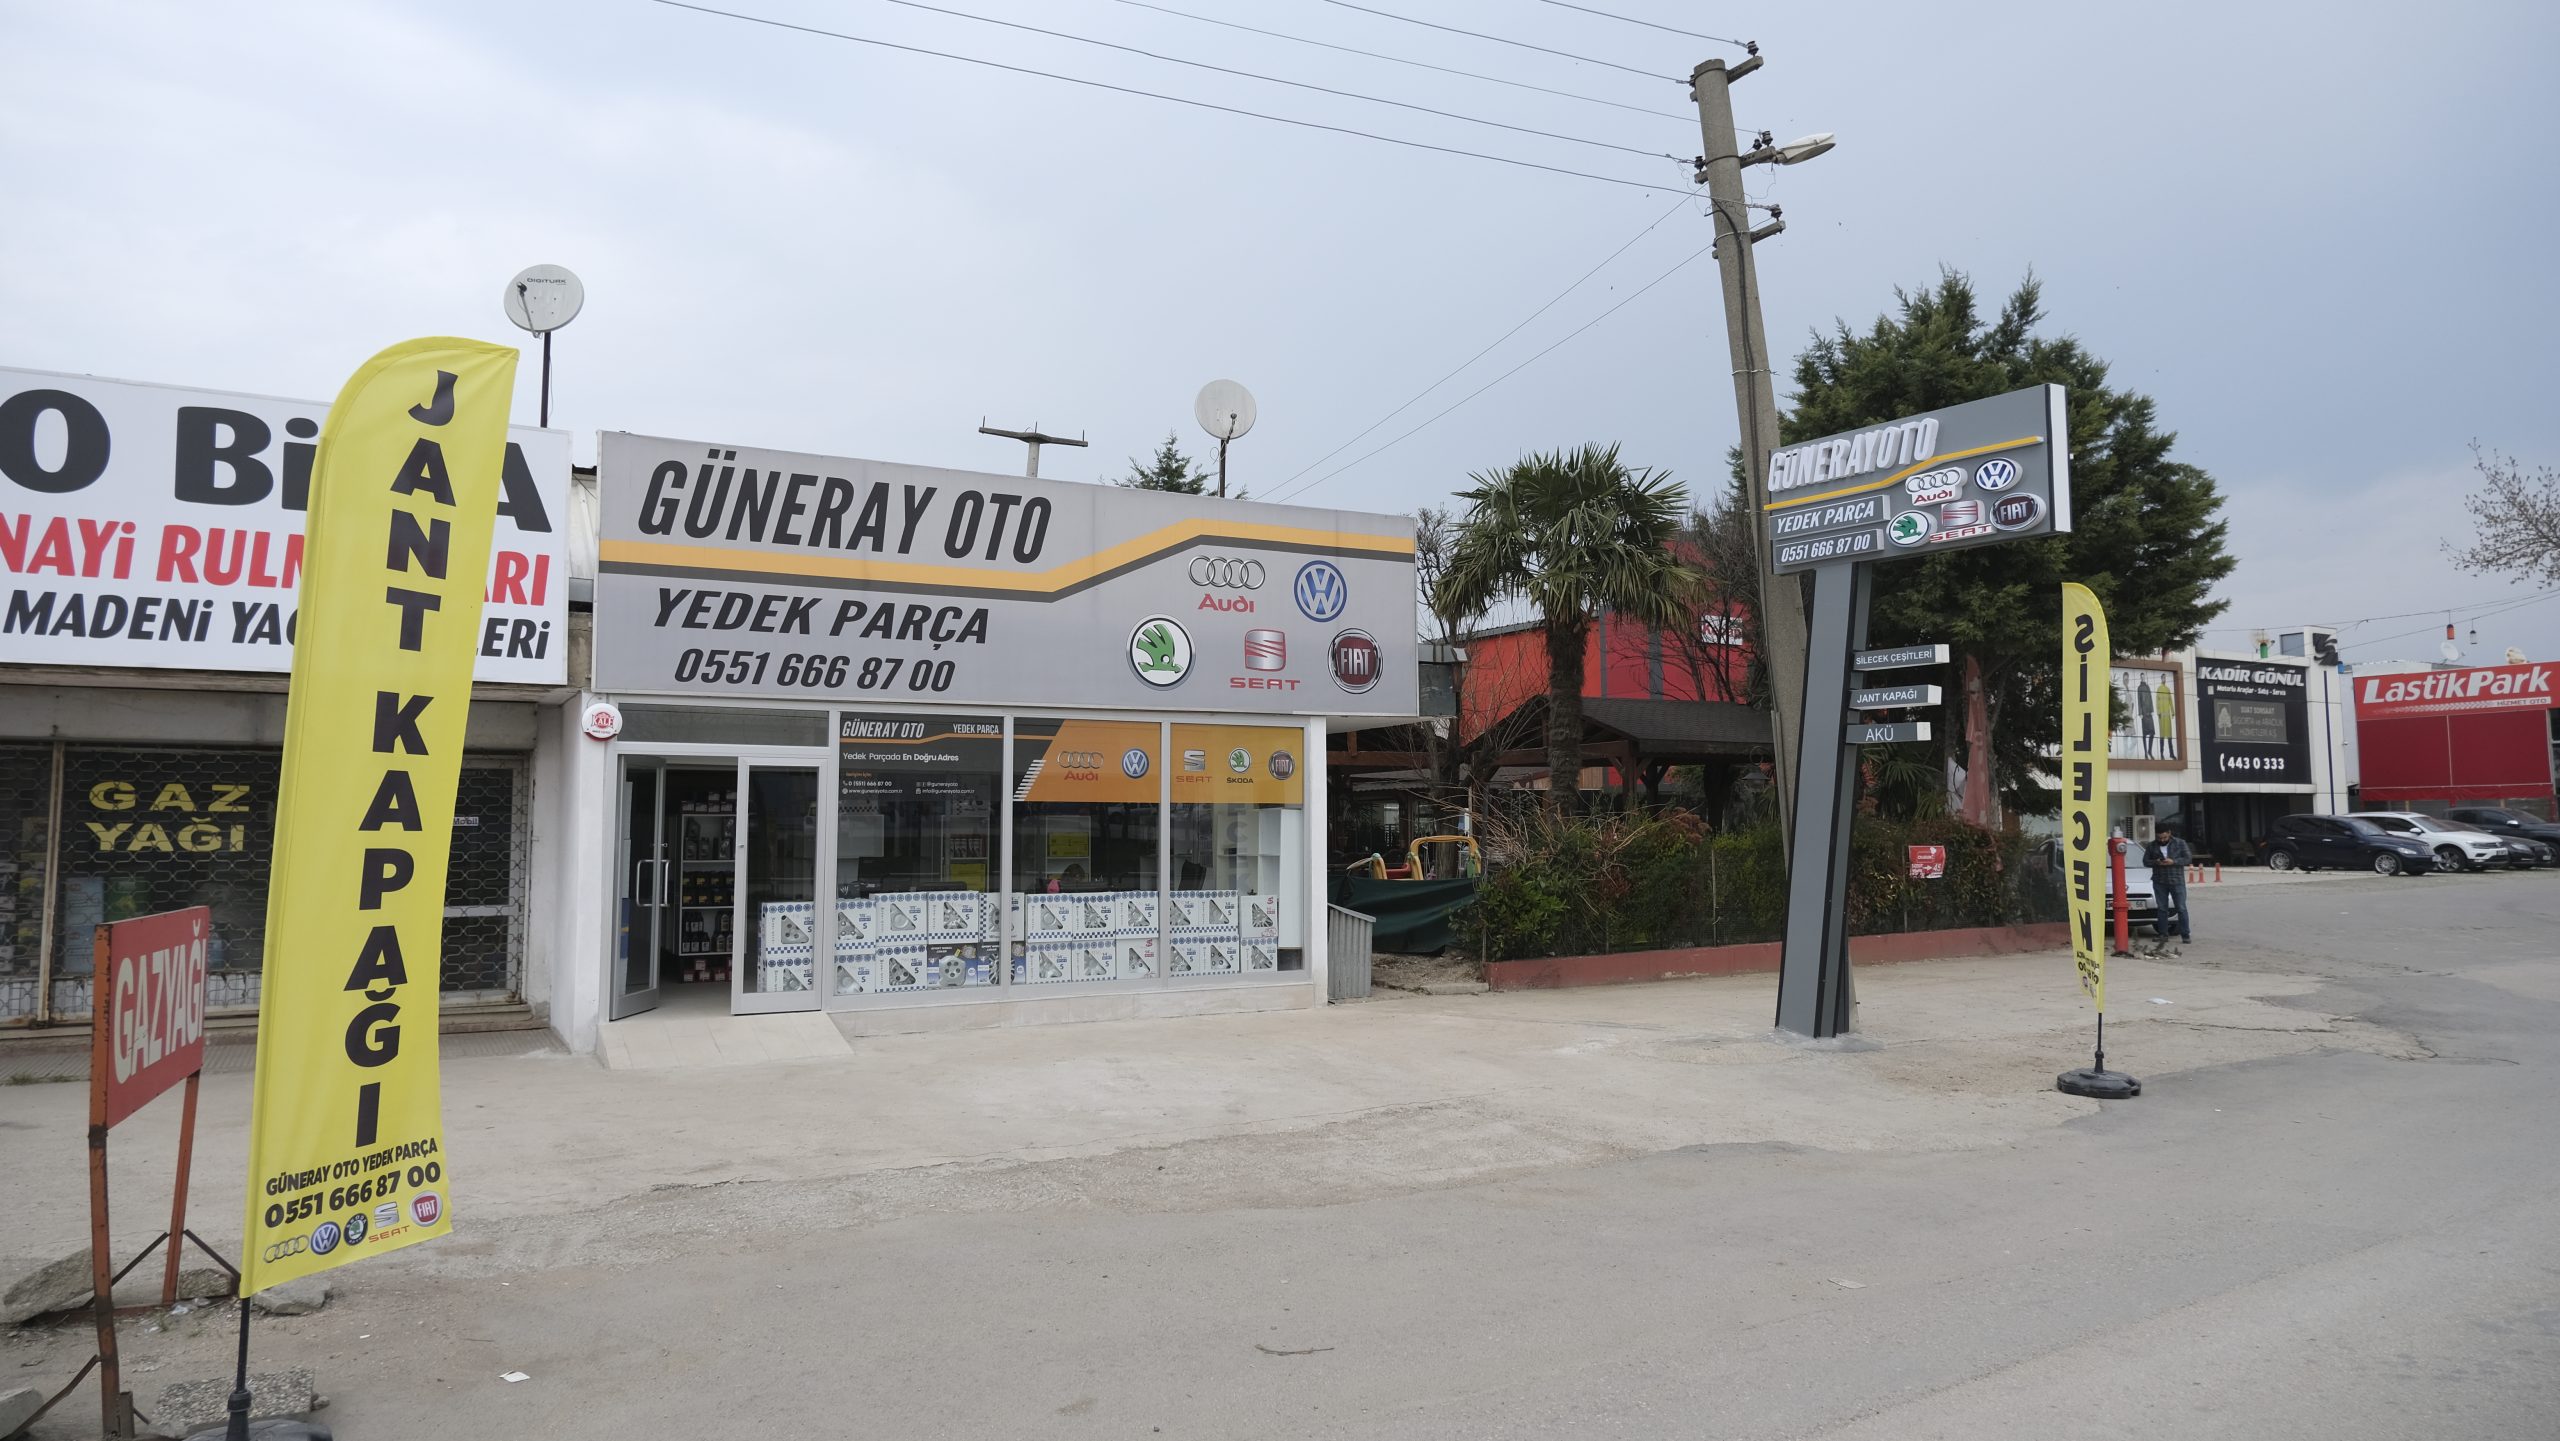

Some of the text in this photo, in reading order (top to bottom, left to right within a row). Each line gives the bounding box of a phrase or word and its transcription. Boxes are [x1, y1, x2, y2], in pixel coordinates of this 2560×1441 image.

[637, 449, 1052, 564] GÜNERAY OTO
[1913, 489, 1953, 504] Audi
[1776, 500, 1874, 534] YEDEK PARÇA
[1999, 500, 2031, 523] FIAT
[1930, 524, 1992, 543] SEAT
[1781, 533, 1871, 563] 0551 666 87 00
[1198, 593, 1255, 613] Audi
[3, 589, 213, 642] MADENi
[654, 587, 989, 650] YEDEK PARÇA
[1340, 647, 1371, 676] FIAT
[1855, 649, 1932, 665] SİLECEK ÇEŞİTLERİ
[674, 648, 955, 692] 0551 666 87 00
[2199, 665, 2305, 687] KADİR GÖNÜL
[1230, 677, 1300, 691] SEAT
[1857, 689, 1917, 703] JANT KAPAĞI
[842, 718, 999, 738] GÜNERAY OTO YEDEK PARÇA
[1865, 725, 1894, 741] AKÜ
[343, 369, 459, 1148] JANT KAPAĞI
[843, 752, 867, 760] Yedek
[869, 752, 901, 762] Parçada
[903, 753, 912, 761] En
[914, 753, 937, 763] Doğru
[2228, 756, 2285, 770] 443 0 333
[1064, 770, 1099, 781] Audi
[1176, 775, 1212, 783] SEAT
[89, 781, 250, 812] GAZ
[85, 817, 245, 852] YAĞI
[114, 919, 207, 1084] GAZYAĞI
[266, 1137, 438, 1196] GÜNERAY OTO YEDEK PARÇA
[265, 1161, 441, 1228] 0551 666 87 00
[417, 1199, 436, 1217] FIAT
[369, 1225, 410, 1243] SEAT
